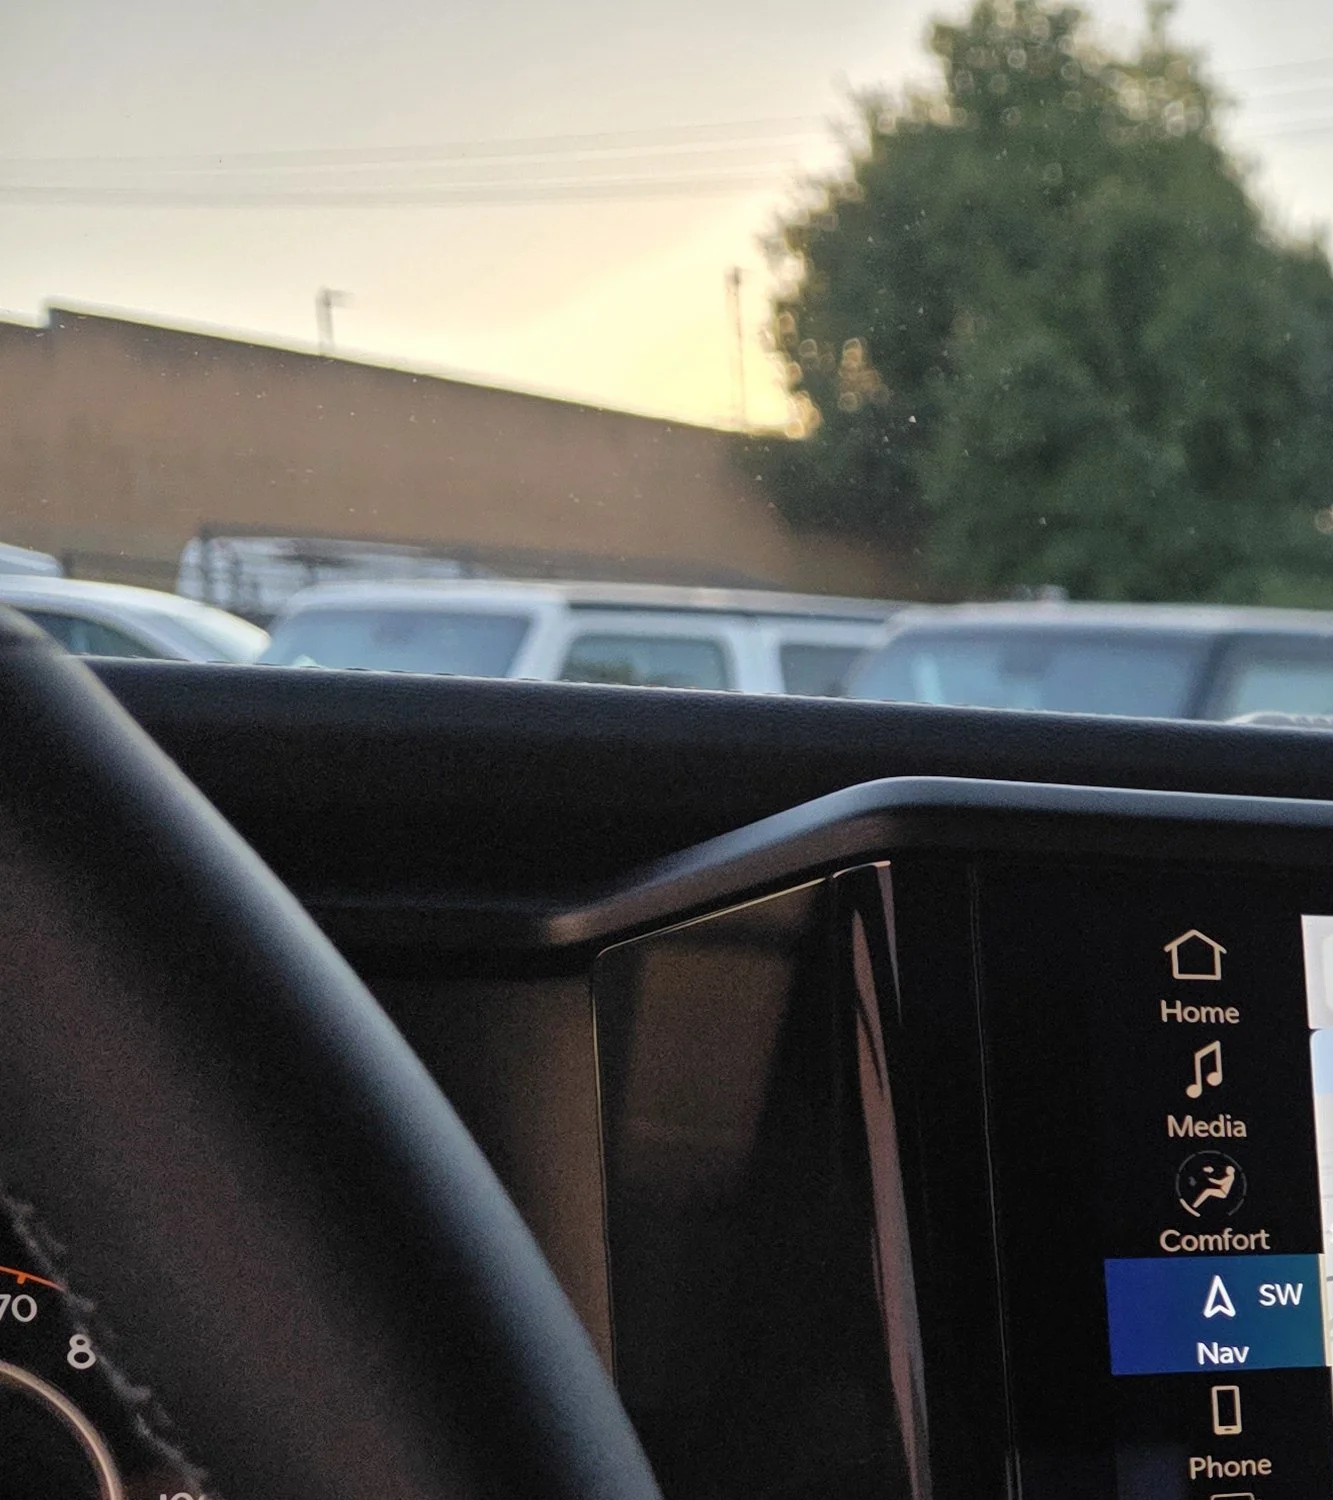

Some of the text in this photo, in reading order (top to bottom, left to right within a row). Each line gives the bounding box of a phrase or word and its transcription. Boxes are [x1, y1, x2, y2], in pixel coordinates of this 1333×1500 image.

[1160, 1000, 1240, 1024] Home
[1167, 1115, 1247, 1138] Media
[1160, 1228, 1270, 1253] Comfort
[1259, 1283, 1303, 1306] SW
[0, 1293, 38, 1323] 70
[1198, 1343, 1249, 1365] Nav
[1189, 1455, 1272, 1480] Phone
